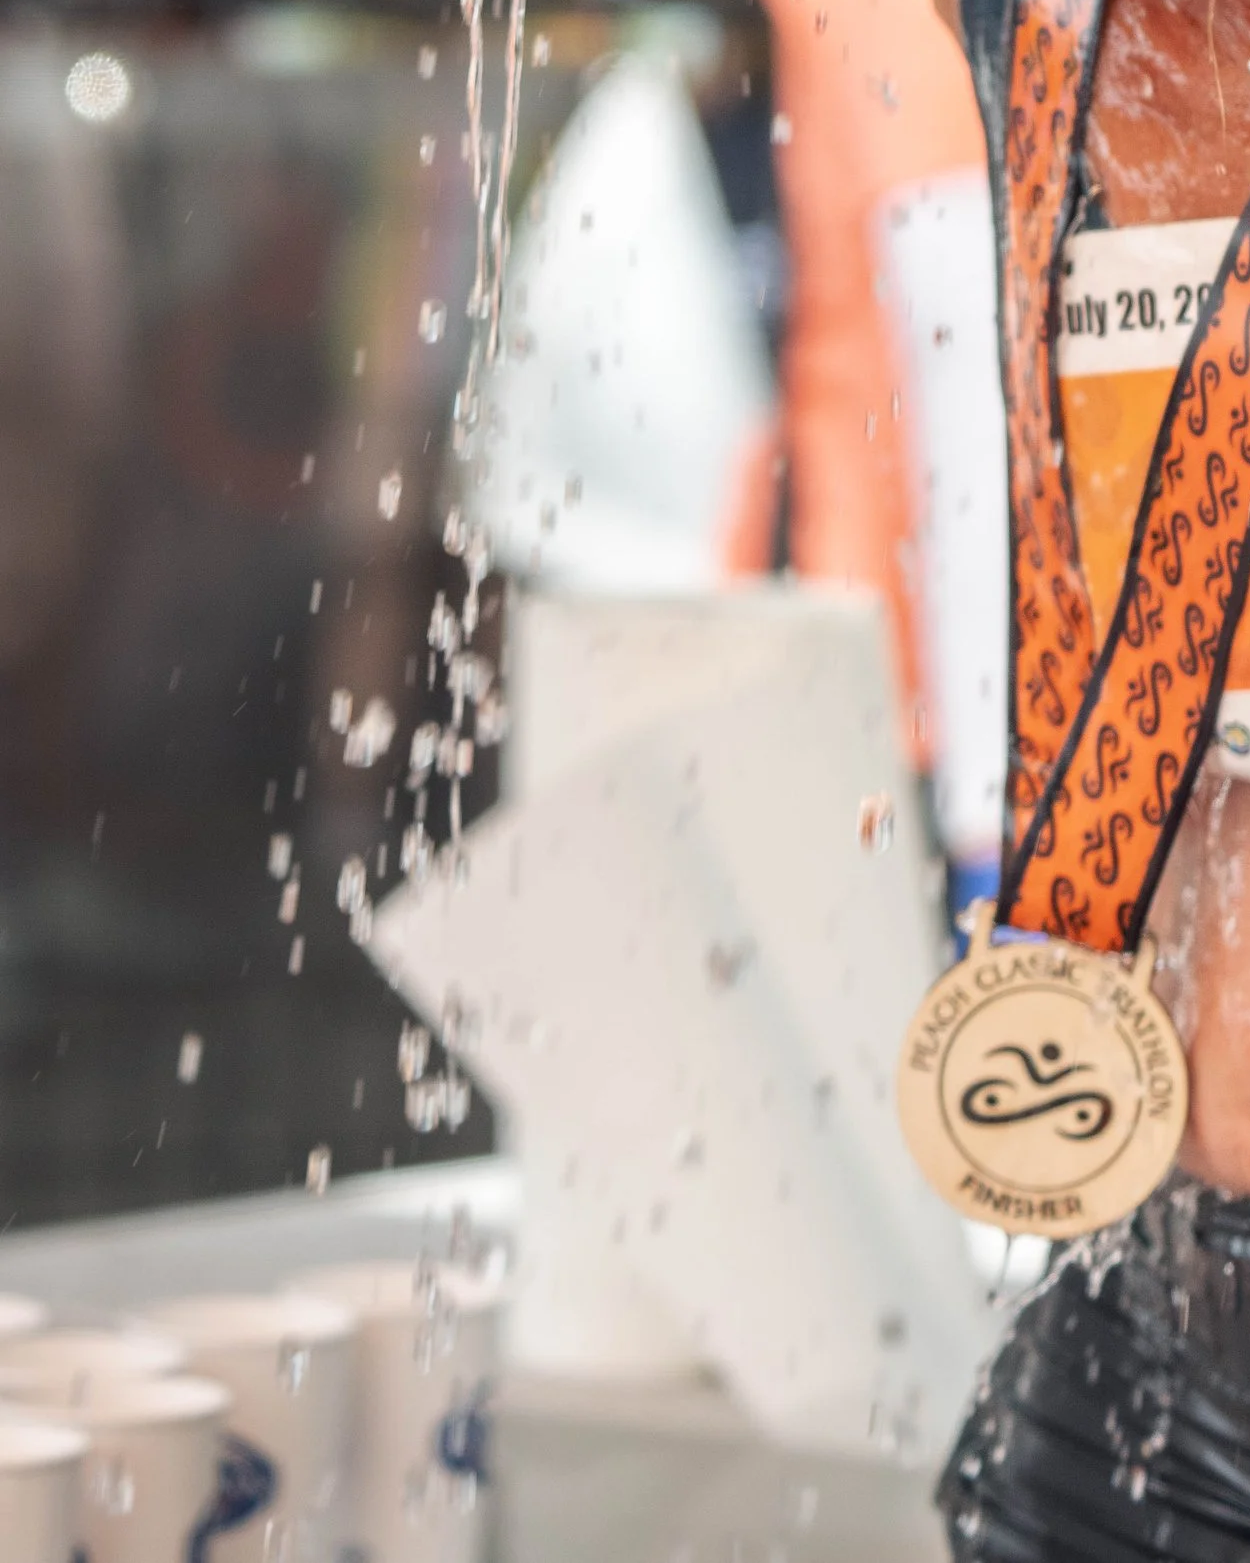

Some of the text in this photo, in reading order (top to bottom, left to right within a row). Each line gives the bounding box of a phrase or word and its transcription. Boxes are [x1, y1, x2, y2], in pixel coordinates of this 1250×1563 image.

[1066, 294, 1107, 337] uly
[1116, 288, 1165, 332] 20,
[958, 1173, 1083, 1221] FINISHER
